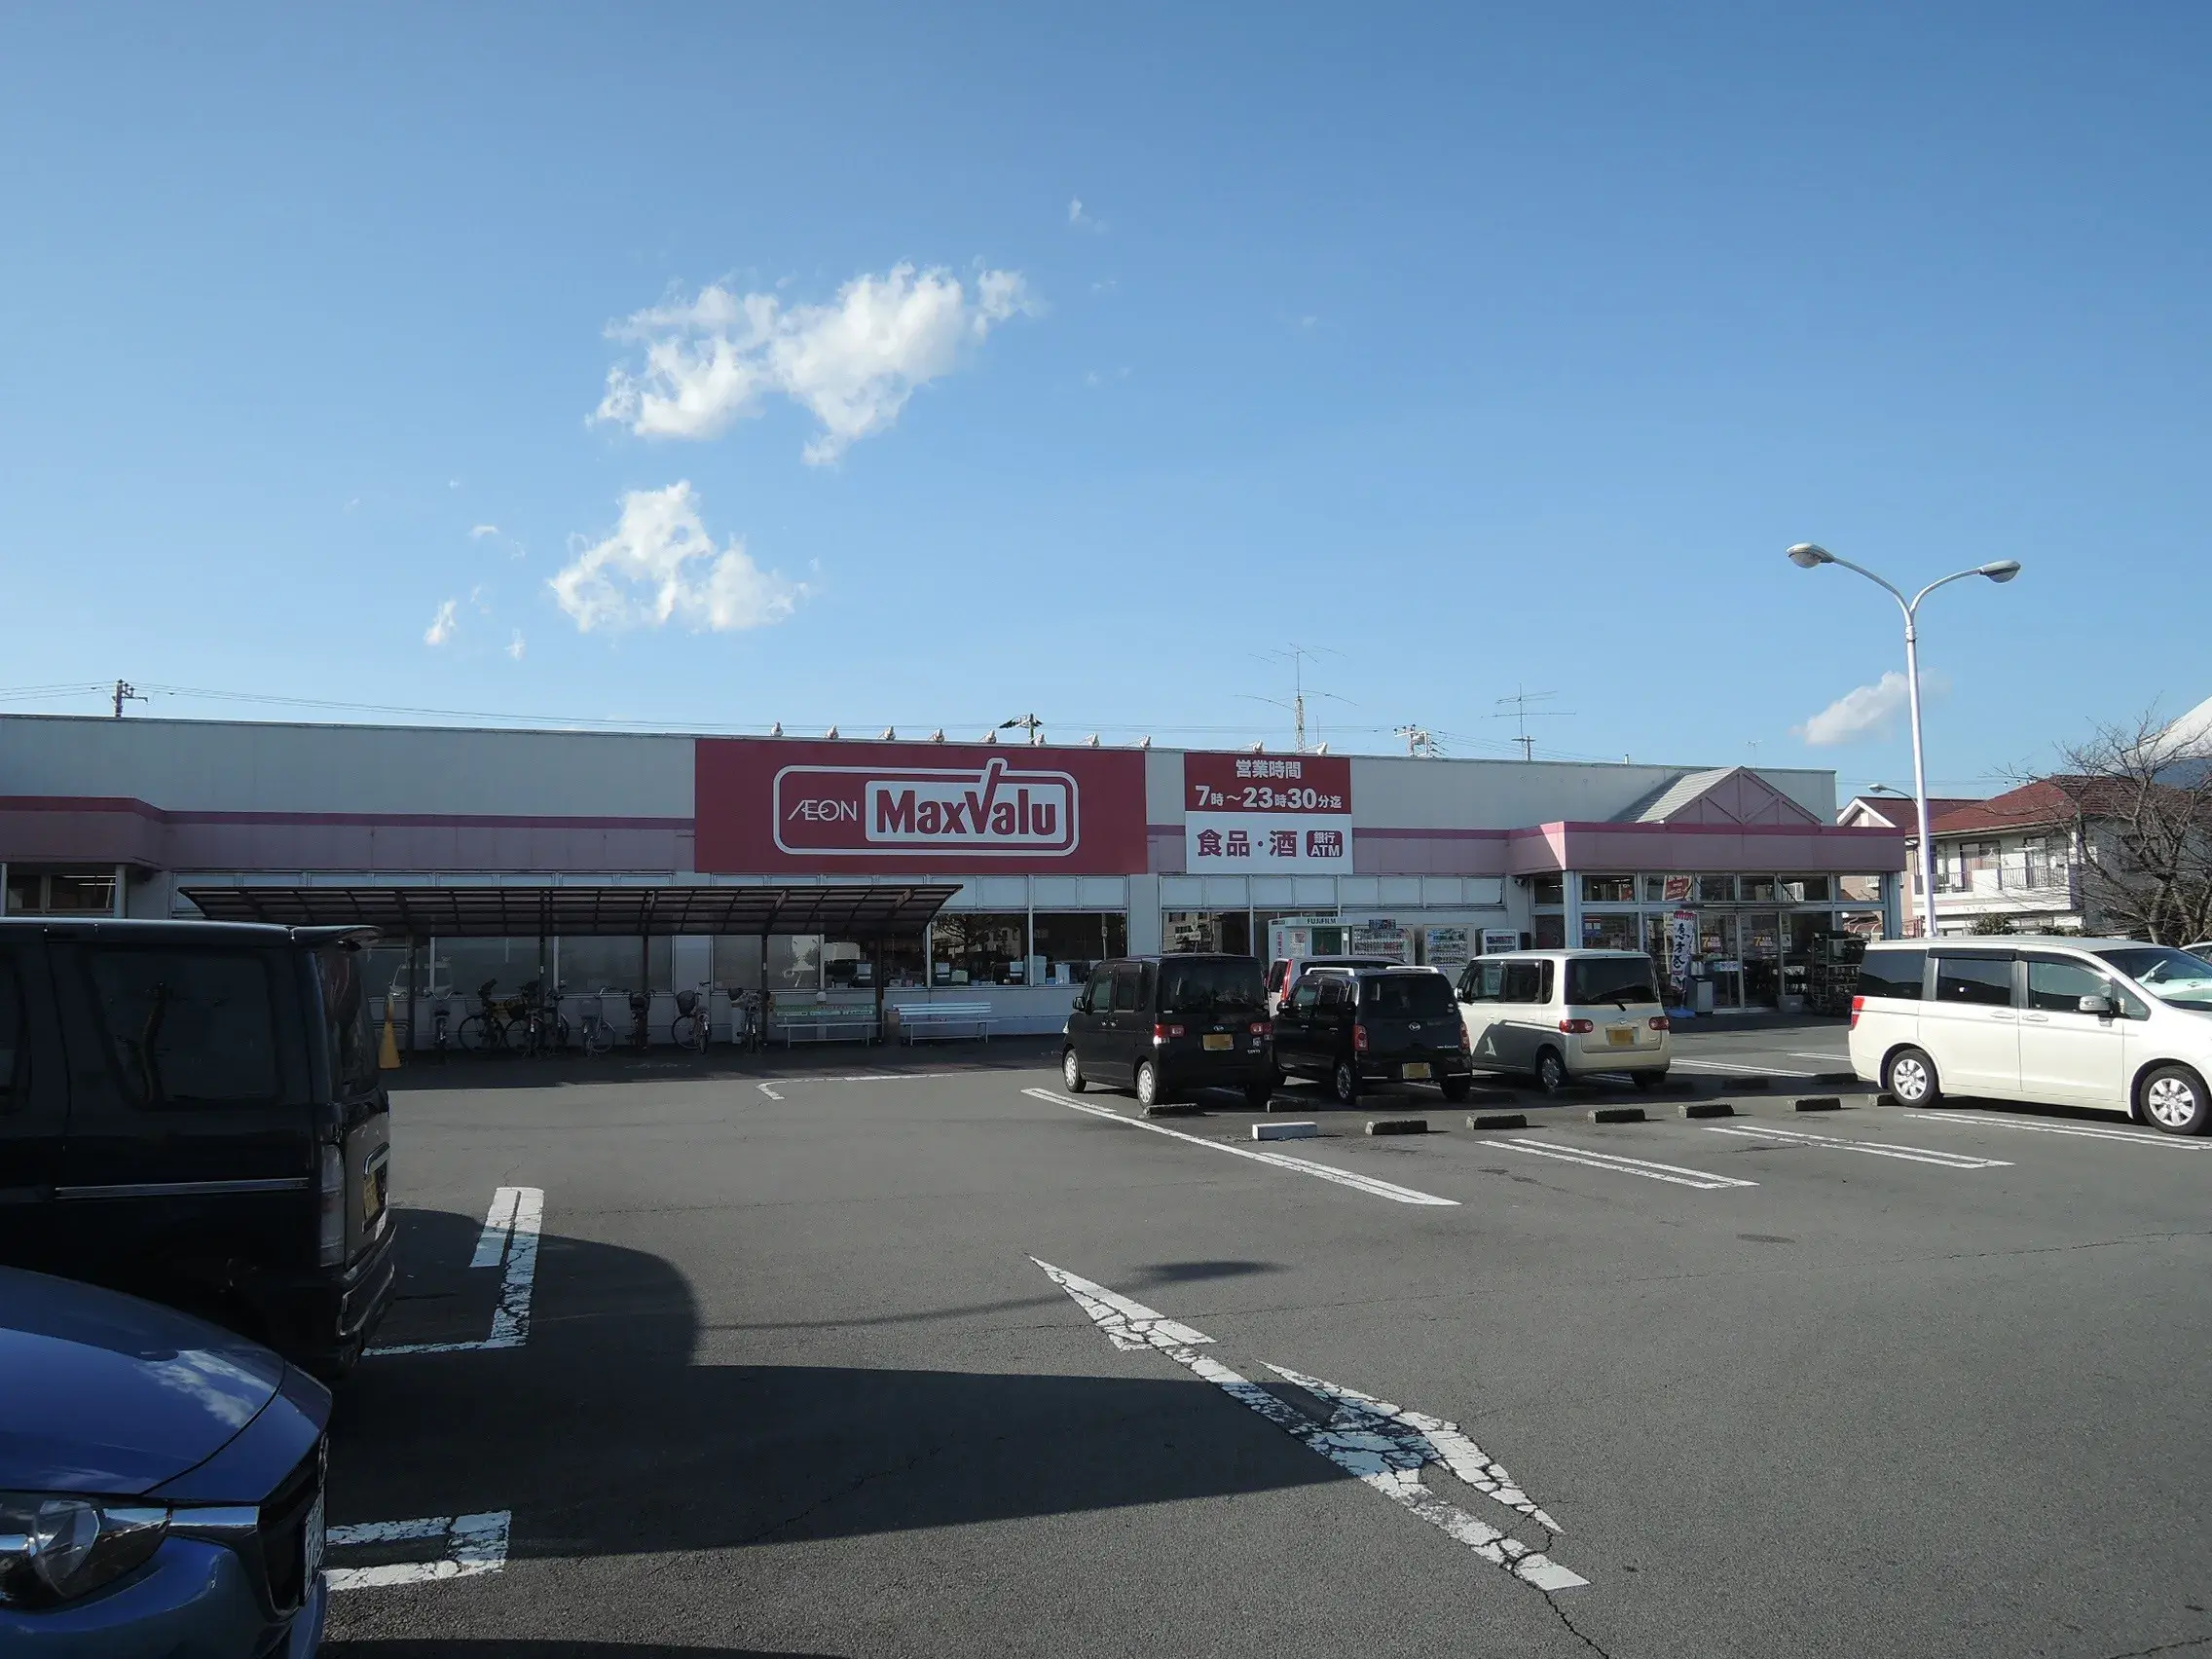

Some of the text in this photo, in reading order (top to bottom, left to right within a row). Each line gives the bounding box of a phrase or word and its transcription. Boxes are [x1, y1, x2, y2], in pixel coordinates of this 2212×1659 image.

[1235, 759, 1302, 779] 営業時間
[876, 762, 1056, 835] MaxValu
[1197, 829, 1298, 858] 食品・酒
[1313, 831, 1336, 844] 銀行
[1309, 845, 1341, 857] ATM
